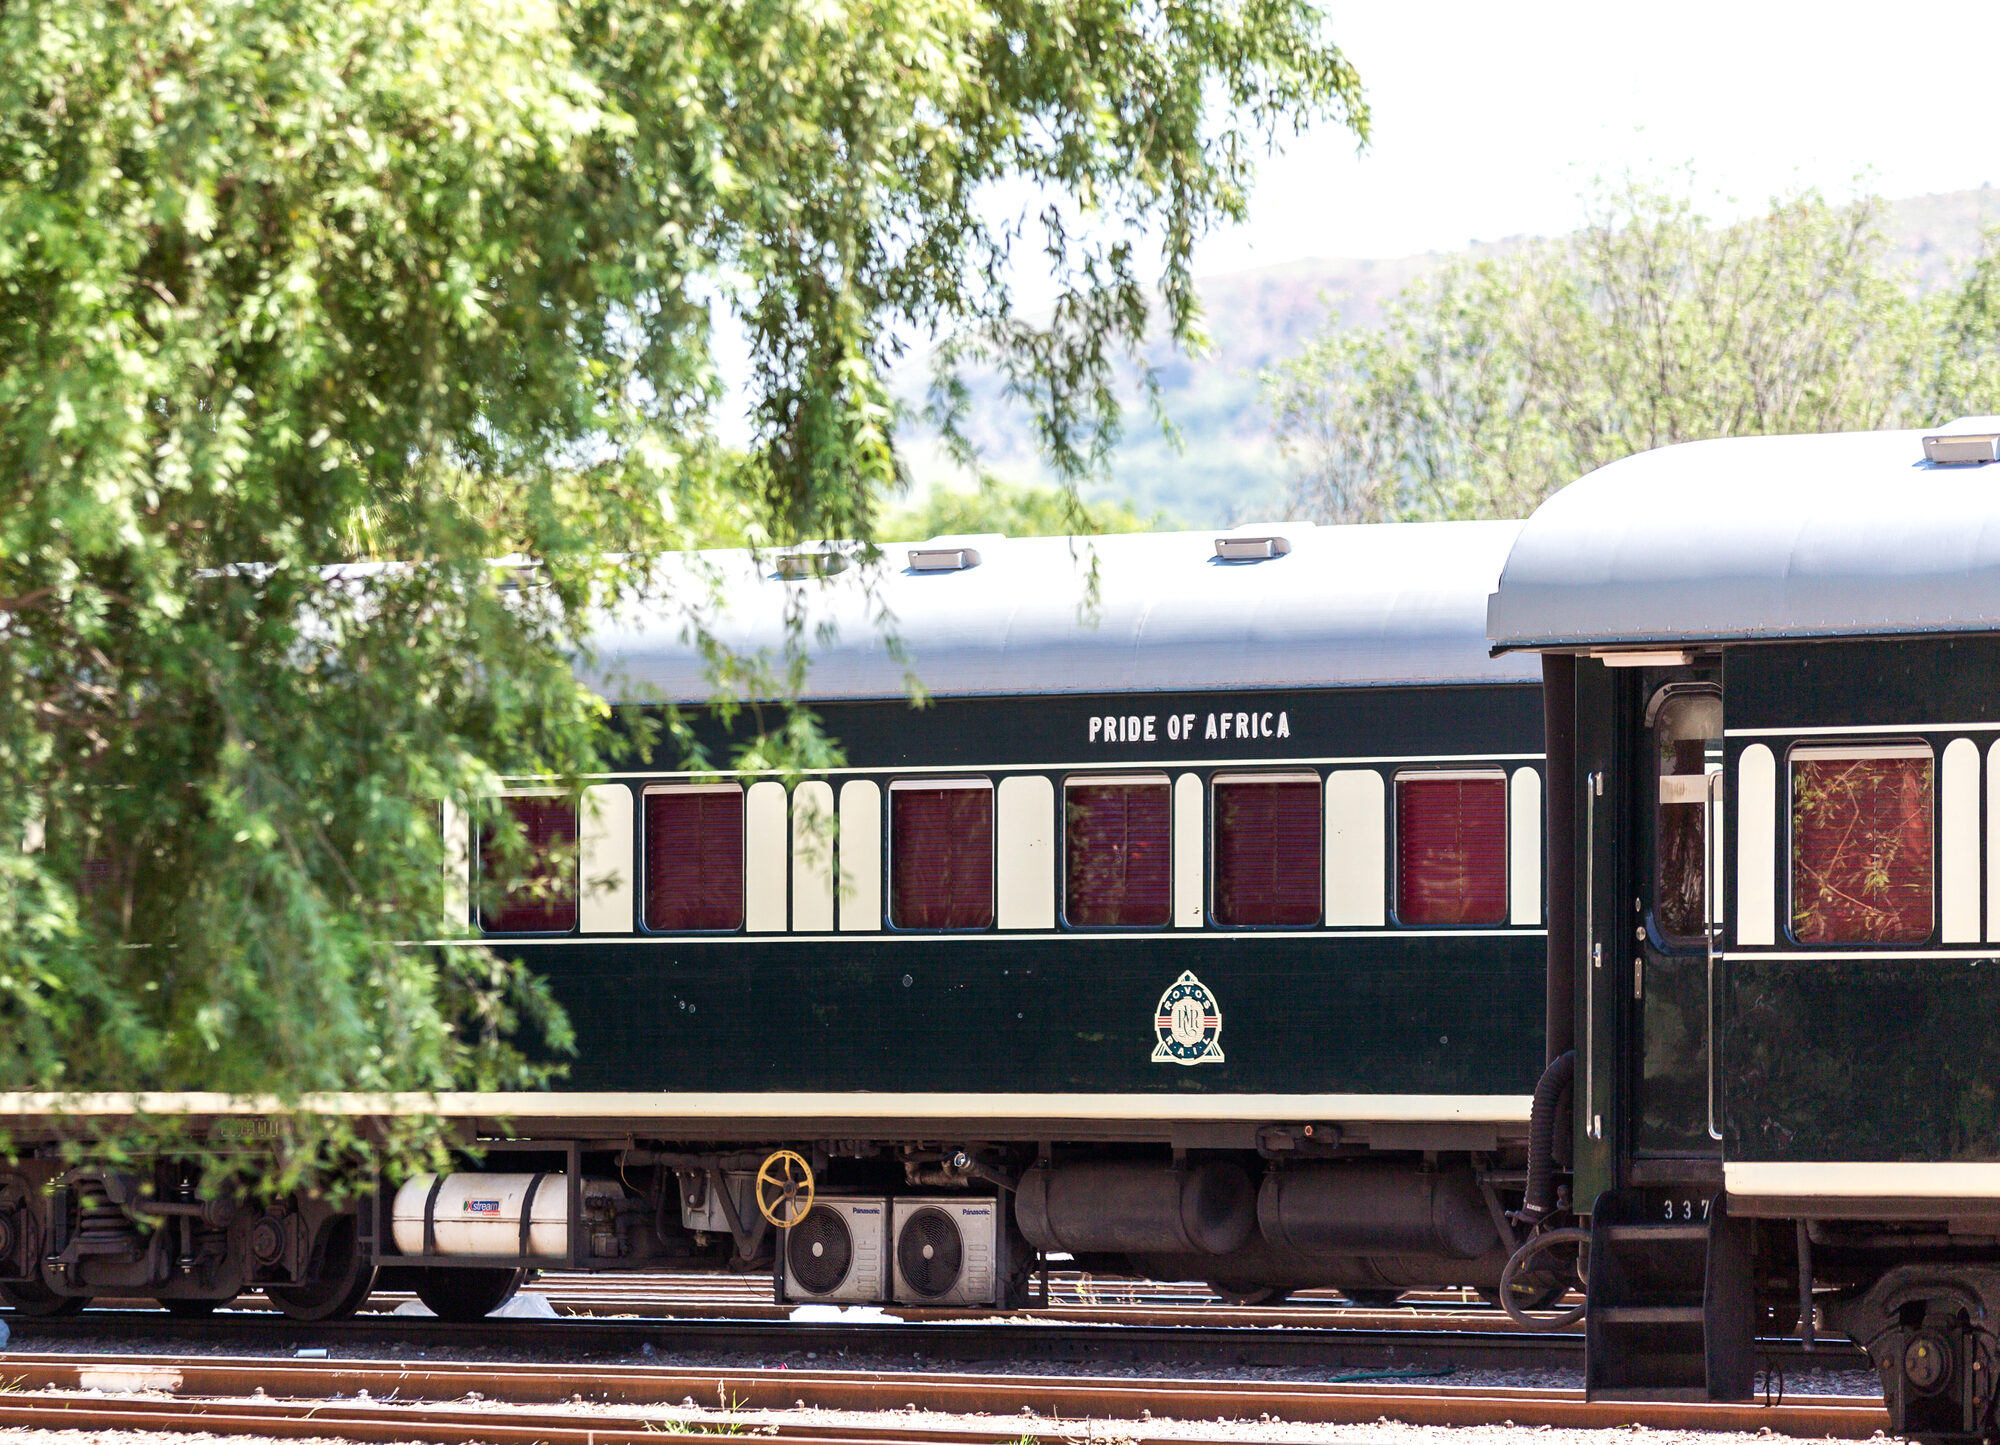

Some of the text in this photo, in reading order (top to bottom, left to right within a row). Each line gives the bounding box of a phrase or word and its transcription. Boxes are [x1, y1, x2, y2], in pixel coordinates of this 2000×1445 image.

[1089, 711, 1290, 742] PRIDE OF AFRICA
[852, 1207, 880, 1215] Panasonic
[962, 1208, 990, 1216] Panasonic
